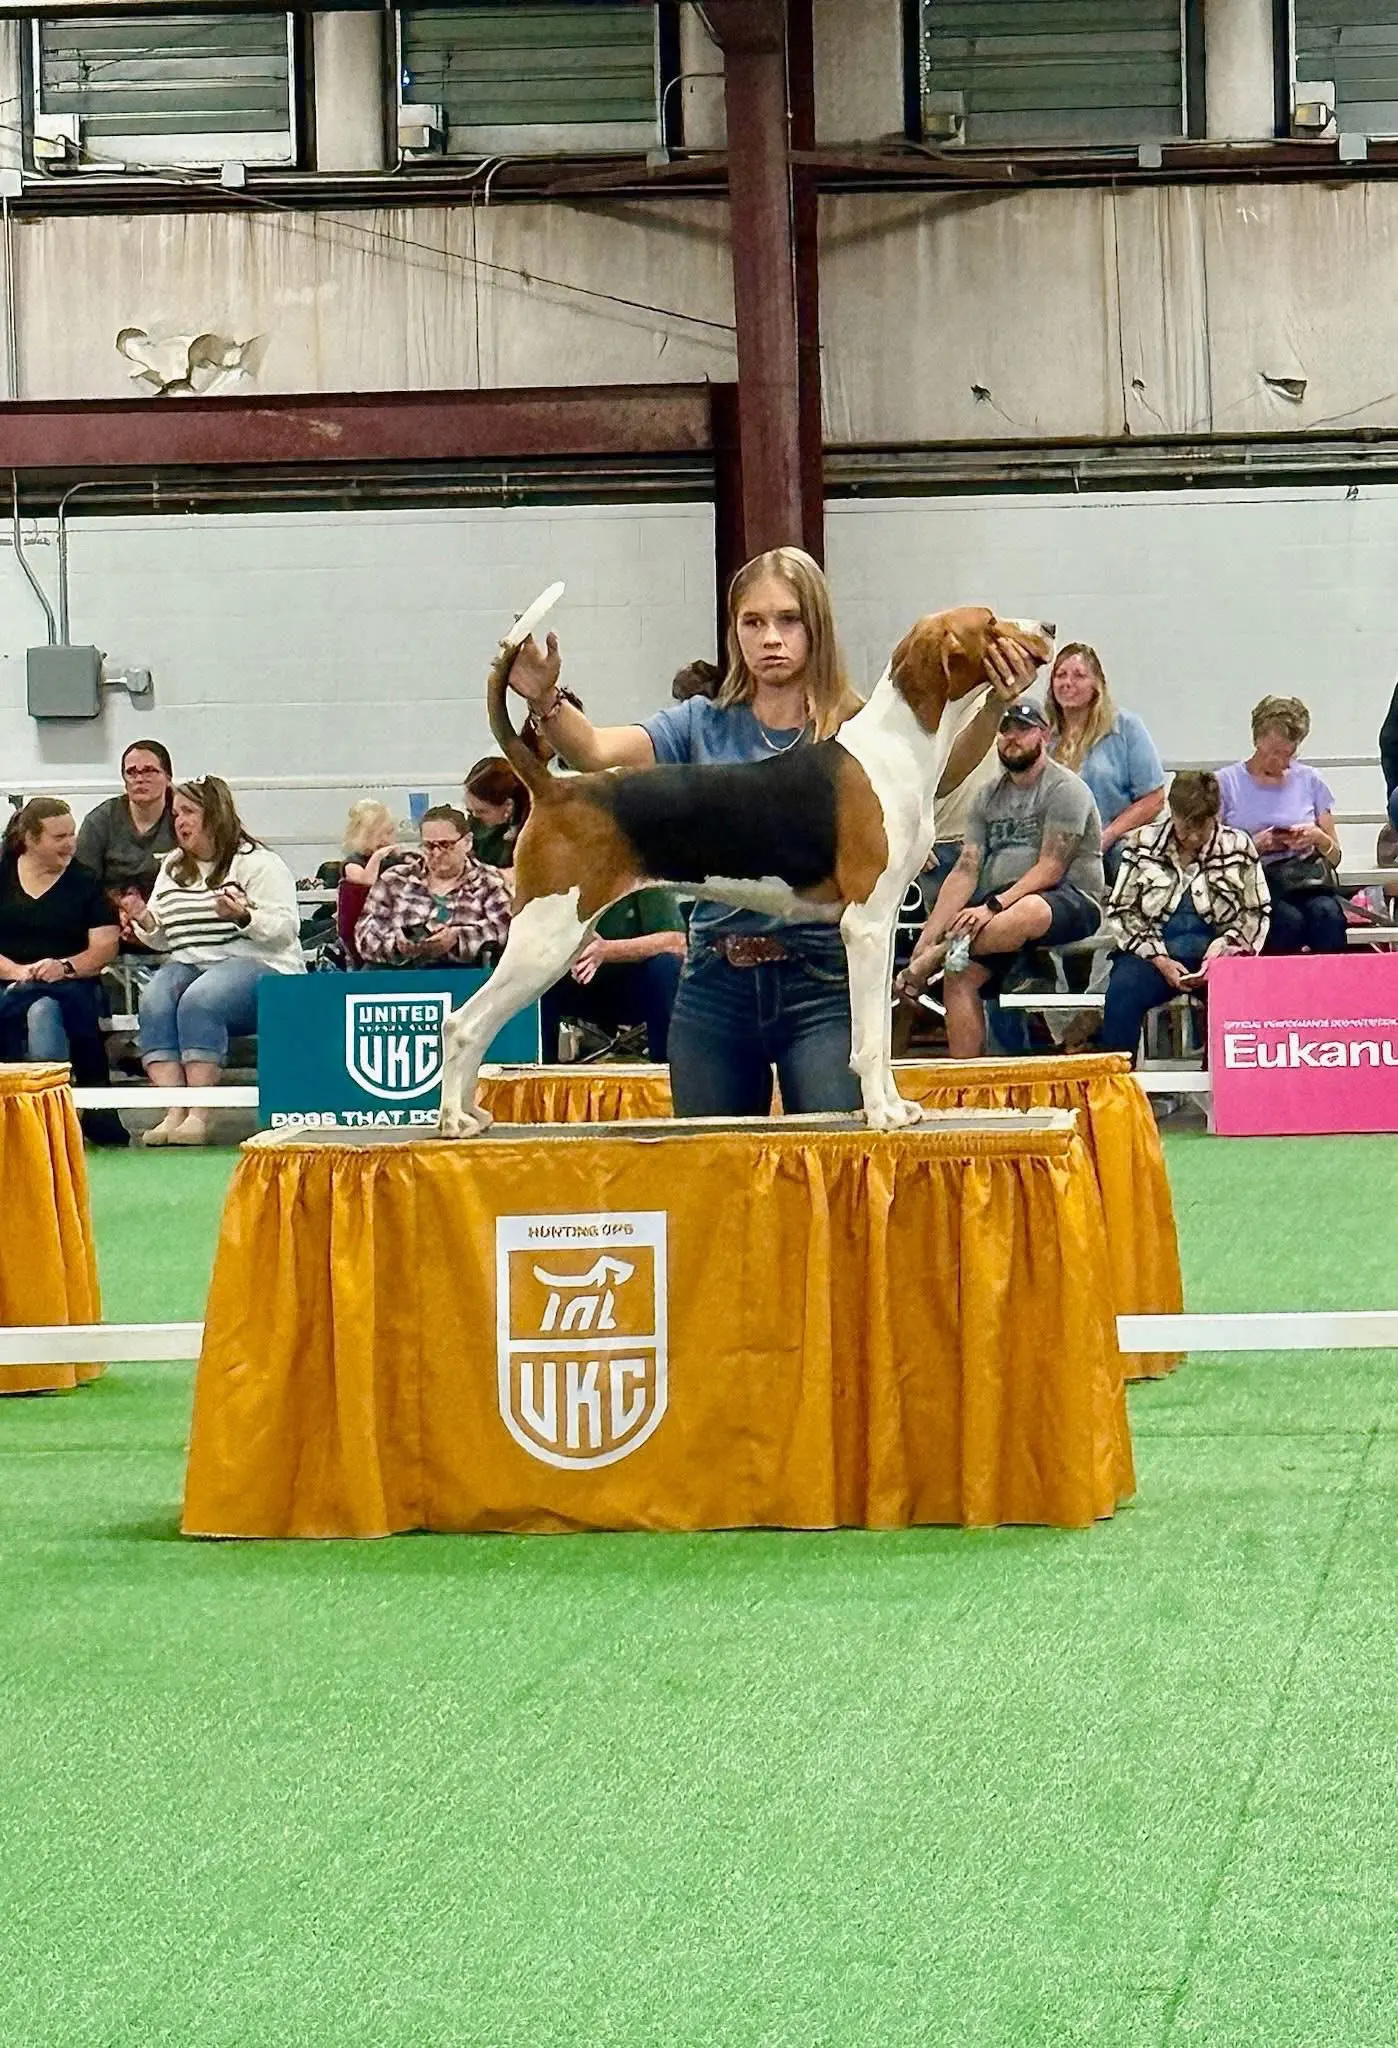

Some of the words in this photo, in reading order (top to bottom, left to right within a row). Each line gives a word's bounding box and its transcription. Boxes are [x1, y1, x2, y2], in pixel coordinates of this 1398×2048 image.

[359, 1005, 438, 1023] UNITED
[359, 1035, 438, 1088] UKC
[342, 1110, 403, 1126] THAT
[528, 1225, 598, 1238] HUNTING
[520, 1359, 646, 1448] UKC
